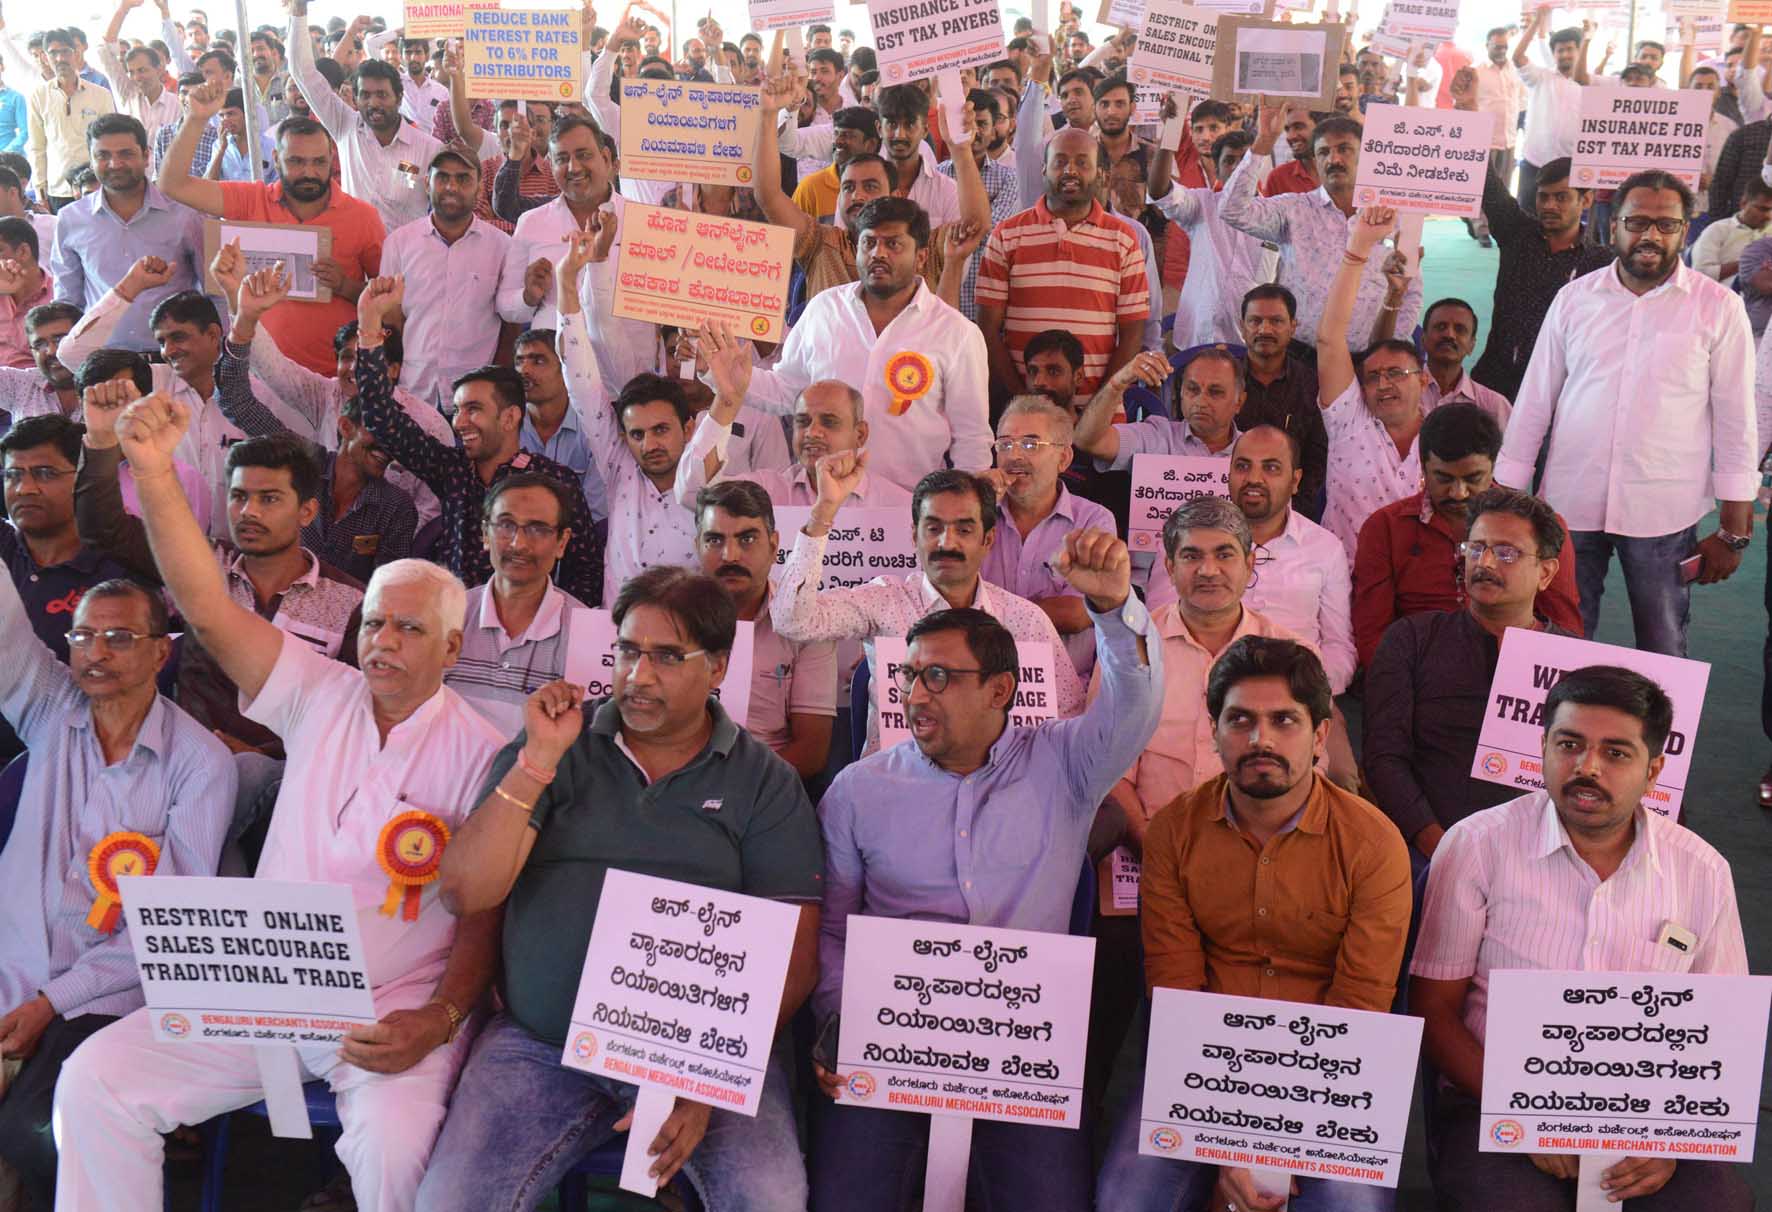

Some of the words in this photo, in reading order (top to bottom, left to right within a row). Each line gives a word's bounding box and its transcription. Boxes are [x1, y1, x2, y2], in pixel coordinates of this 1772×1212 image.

[473, 12, 527, 26] REDUCE
[531, 13, 569, 26] BANK
[873, 0, 960, 28] INSURANCE
[1149, 12, 1199, 33] RESTRICT
[465, 29, 531, 43] INTEREST
[535, 31, 578, 44] RATES
[876, 31, 905, 51] GST
[909, 24, 938, 43] TAX
[941, 9, 1000, 36] PAYERS
[1145, 27, 1177, 41] SALES
[1179, 33, 1217, 50] ENCOU
[485, 46, 504, 60] TO
[507, 47, 528, 61] 6%
[531, 48, 559, 61] FOR
[1138, 40, 1201, 62] TRADITIONAL
[473, 64, 572, 79] DISTRIBUTORS
[1612, 99, 1679, 115] PROVIDE
[1581, 119, 1668, 136] INSURANCE
[1673, 122, 1703, 137] FOR
[1577, 140, 1607, 154] GST
[1611, 141, 1640, 156] TAX
[1644, 143, 1702, 159] PAYERS
[1373, 162, 1403, 176] ವಿಮೆ
[1407, 164, 1469, 182] ನೀಡಬೇಕು
[647, 210, 688, 233] ಹೊಸ
[828, 527, 864, 542] ಎಸ್.
[870, 527, 885, 542] ಟಿ
[869, 553, 917, 569] ಉಚಿತ
[1496, 694, 1545, 727] TRA
[139, 907, 248, 928] RESTRICT
[264, 911, 345, 933] ONLINE
[145, 936, 215, 954] SALES
[221, 937, 351, 961] ENCOURAGE
[629, 932, 747, 977] ವ್ಯಾಪಾರದಲ್ಲಿನ
[142, 963, 288, 985] TRADITIONAL
[294, 968, 365, 990] TRADE
[610, 965, 750, 1015] ರಿಯಾಯಿತಿಗಳಿಗೆ
[894, 973, 1042, 1010] ವ್ಯಾಪಾರದಲ್ಲಿನ
[310, 1019, 362, 1030] ASSOCIAT
[593, 1002, 692, 1043] ನಿಯಮಾವಳಿ
[700, 1027, 748, 1059] ಬೇಕು
[877, 1007, 1053, 1042] ರಿಯಾಯಿತಿಗಳಿಗೆ
[1542, 1022, 1710, 1053] ವ್ಯಾಪಾರದಲ್ಲಿನ
[863, 1043, 990, 1073] ನಿಯಮಾವಳಿ
[1001, 1055, 1060, 1081] ಬೇಕು
[1201, 1043, 1362, 1080] ವ್ಯಾಪಾರದಲ್ಲಿನ
[1524, 1055, 1722, 1081] ರಿಯಾಯಿತಿಗಳಿಗೆ
[604, 1056, 648, 1079] BENGALURU
[648, 1068, 695, 1092] MERCHANTS
[695, 1082, 747, 1105] ASSOCIATION
[1184, 1072, 1373, 1110] ರಿಯಾಯಿತಿಗಳಿಗೆ
[888, 1091, 944, 1108] BENGALURU
[945, 1098, 1003, 1115] MERCHANTS
[1005, 1105, 1066, 1121] ASSOCIATION
[1509, 1091, 1651, 1113] ನಿಯಮಾವಳಿ
[1663, 1095, 1730, 1117] ಬೇಕು
[1169, 1103, 1304, 1136] ನಿಯಮಾವಳಿ
[1316, 1119, 1379, 1146] ಬೇಕು
[1538, 1136, 1600, 1149] BENGALURU
[1601, 1139, 1666, 1153] MERCHANTS
[1668, 1142, 1737, 1156] ASSOCIATION
[1195, 1146, 1254, 1164] BENGALURU
[1255, 1154, 1317, 1172] MERCHANTS
[1318, 1163, 1385, 1181] ASSOCIATION
